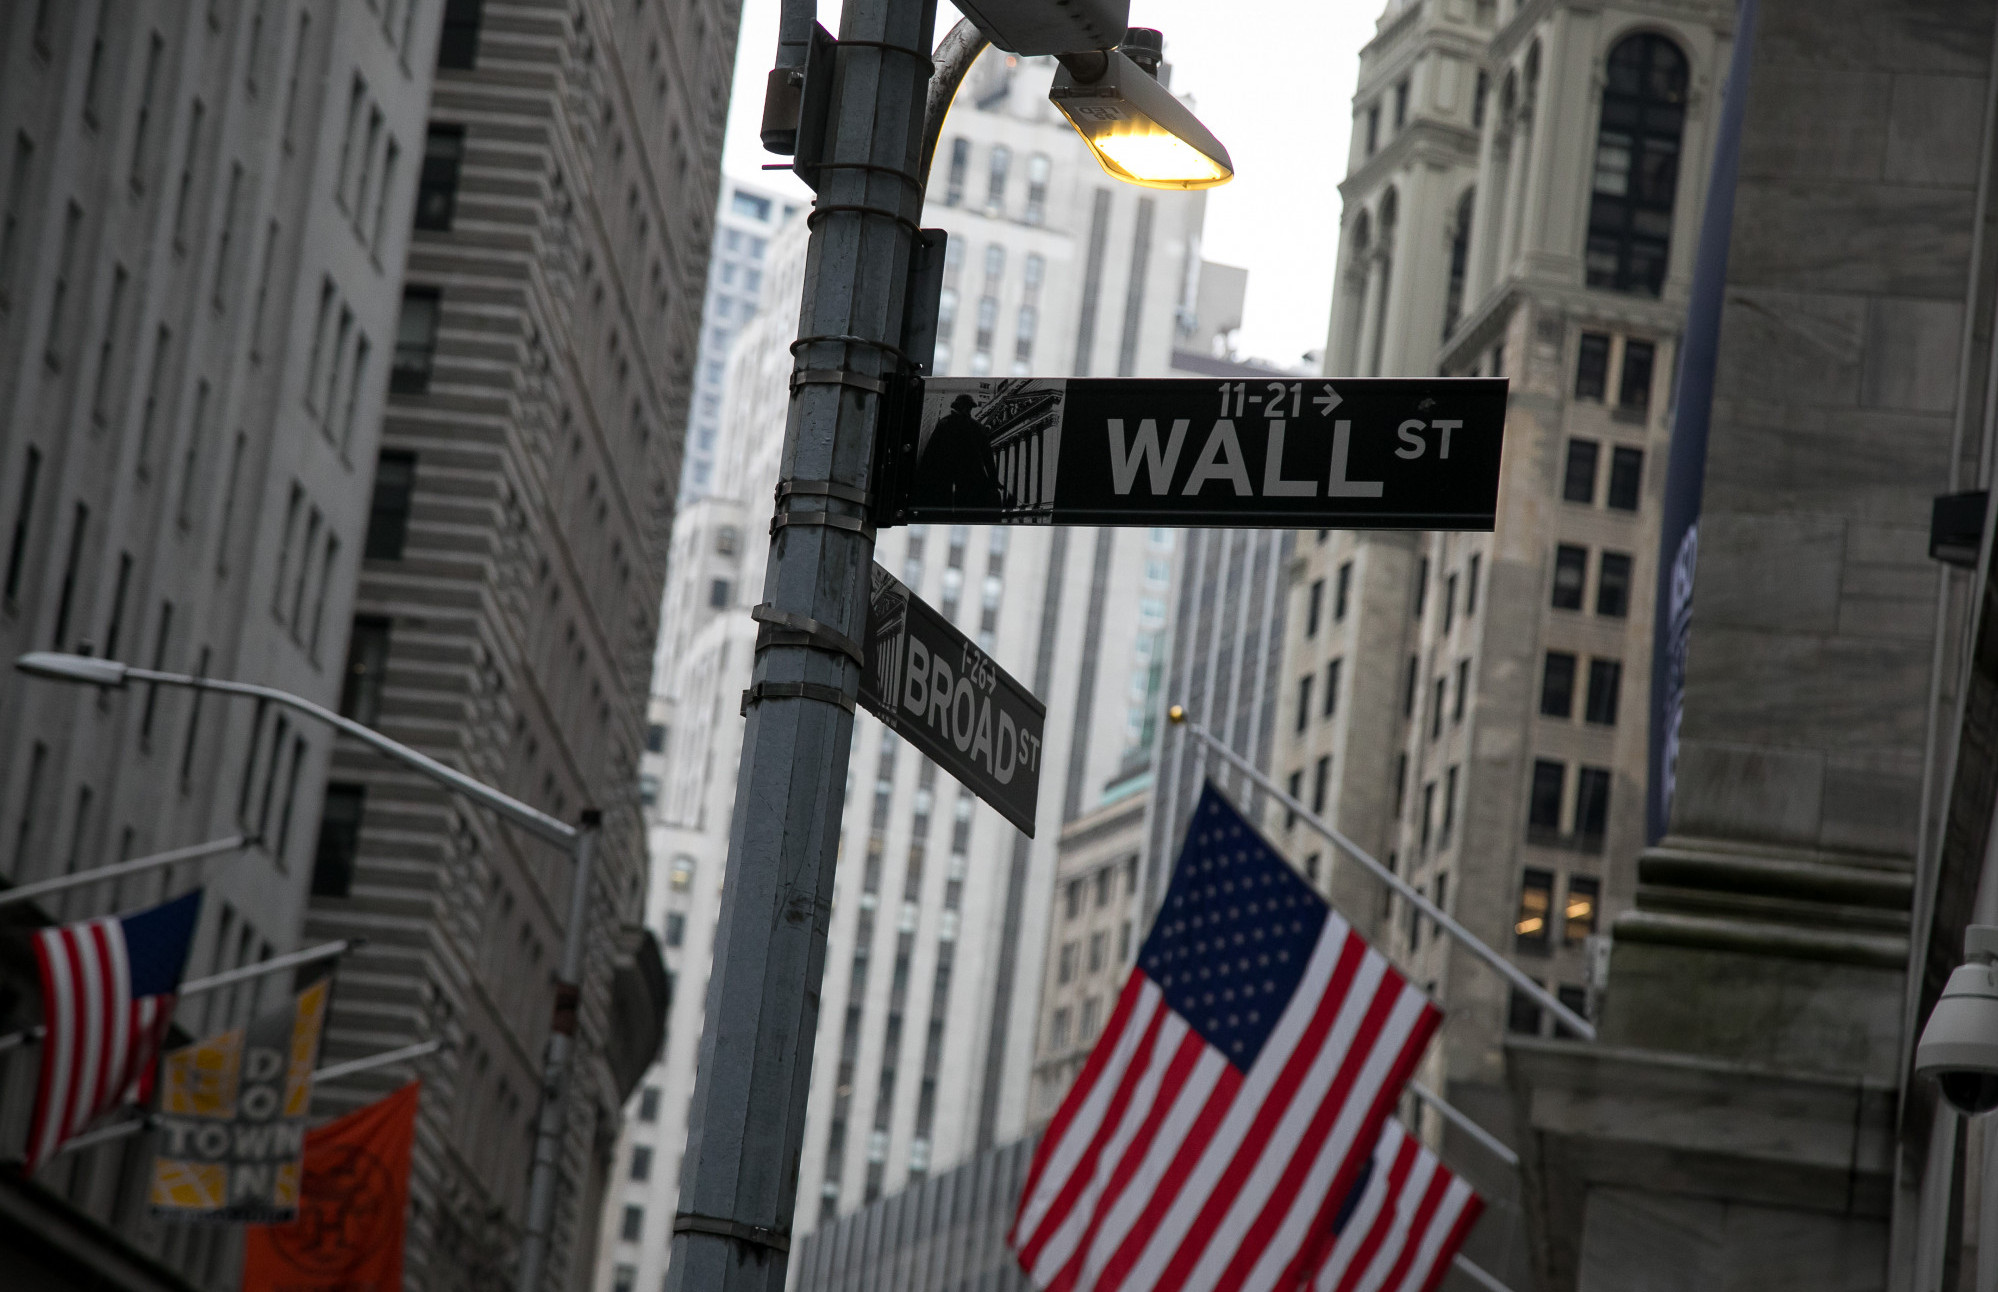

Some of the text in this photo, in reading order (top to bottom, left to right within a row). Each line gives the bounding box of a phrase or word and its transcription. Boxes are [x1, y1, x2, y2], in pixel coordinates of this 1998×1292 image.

[1217, 381, 1302, 418] 11-21
[1107, 417, 1464, 498] WALL ST
[961, 641, 988, 690] 1-26
[903, 634, 1041, 785] BROAD ST
